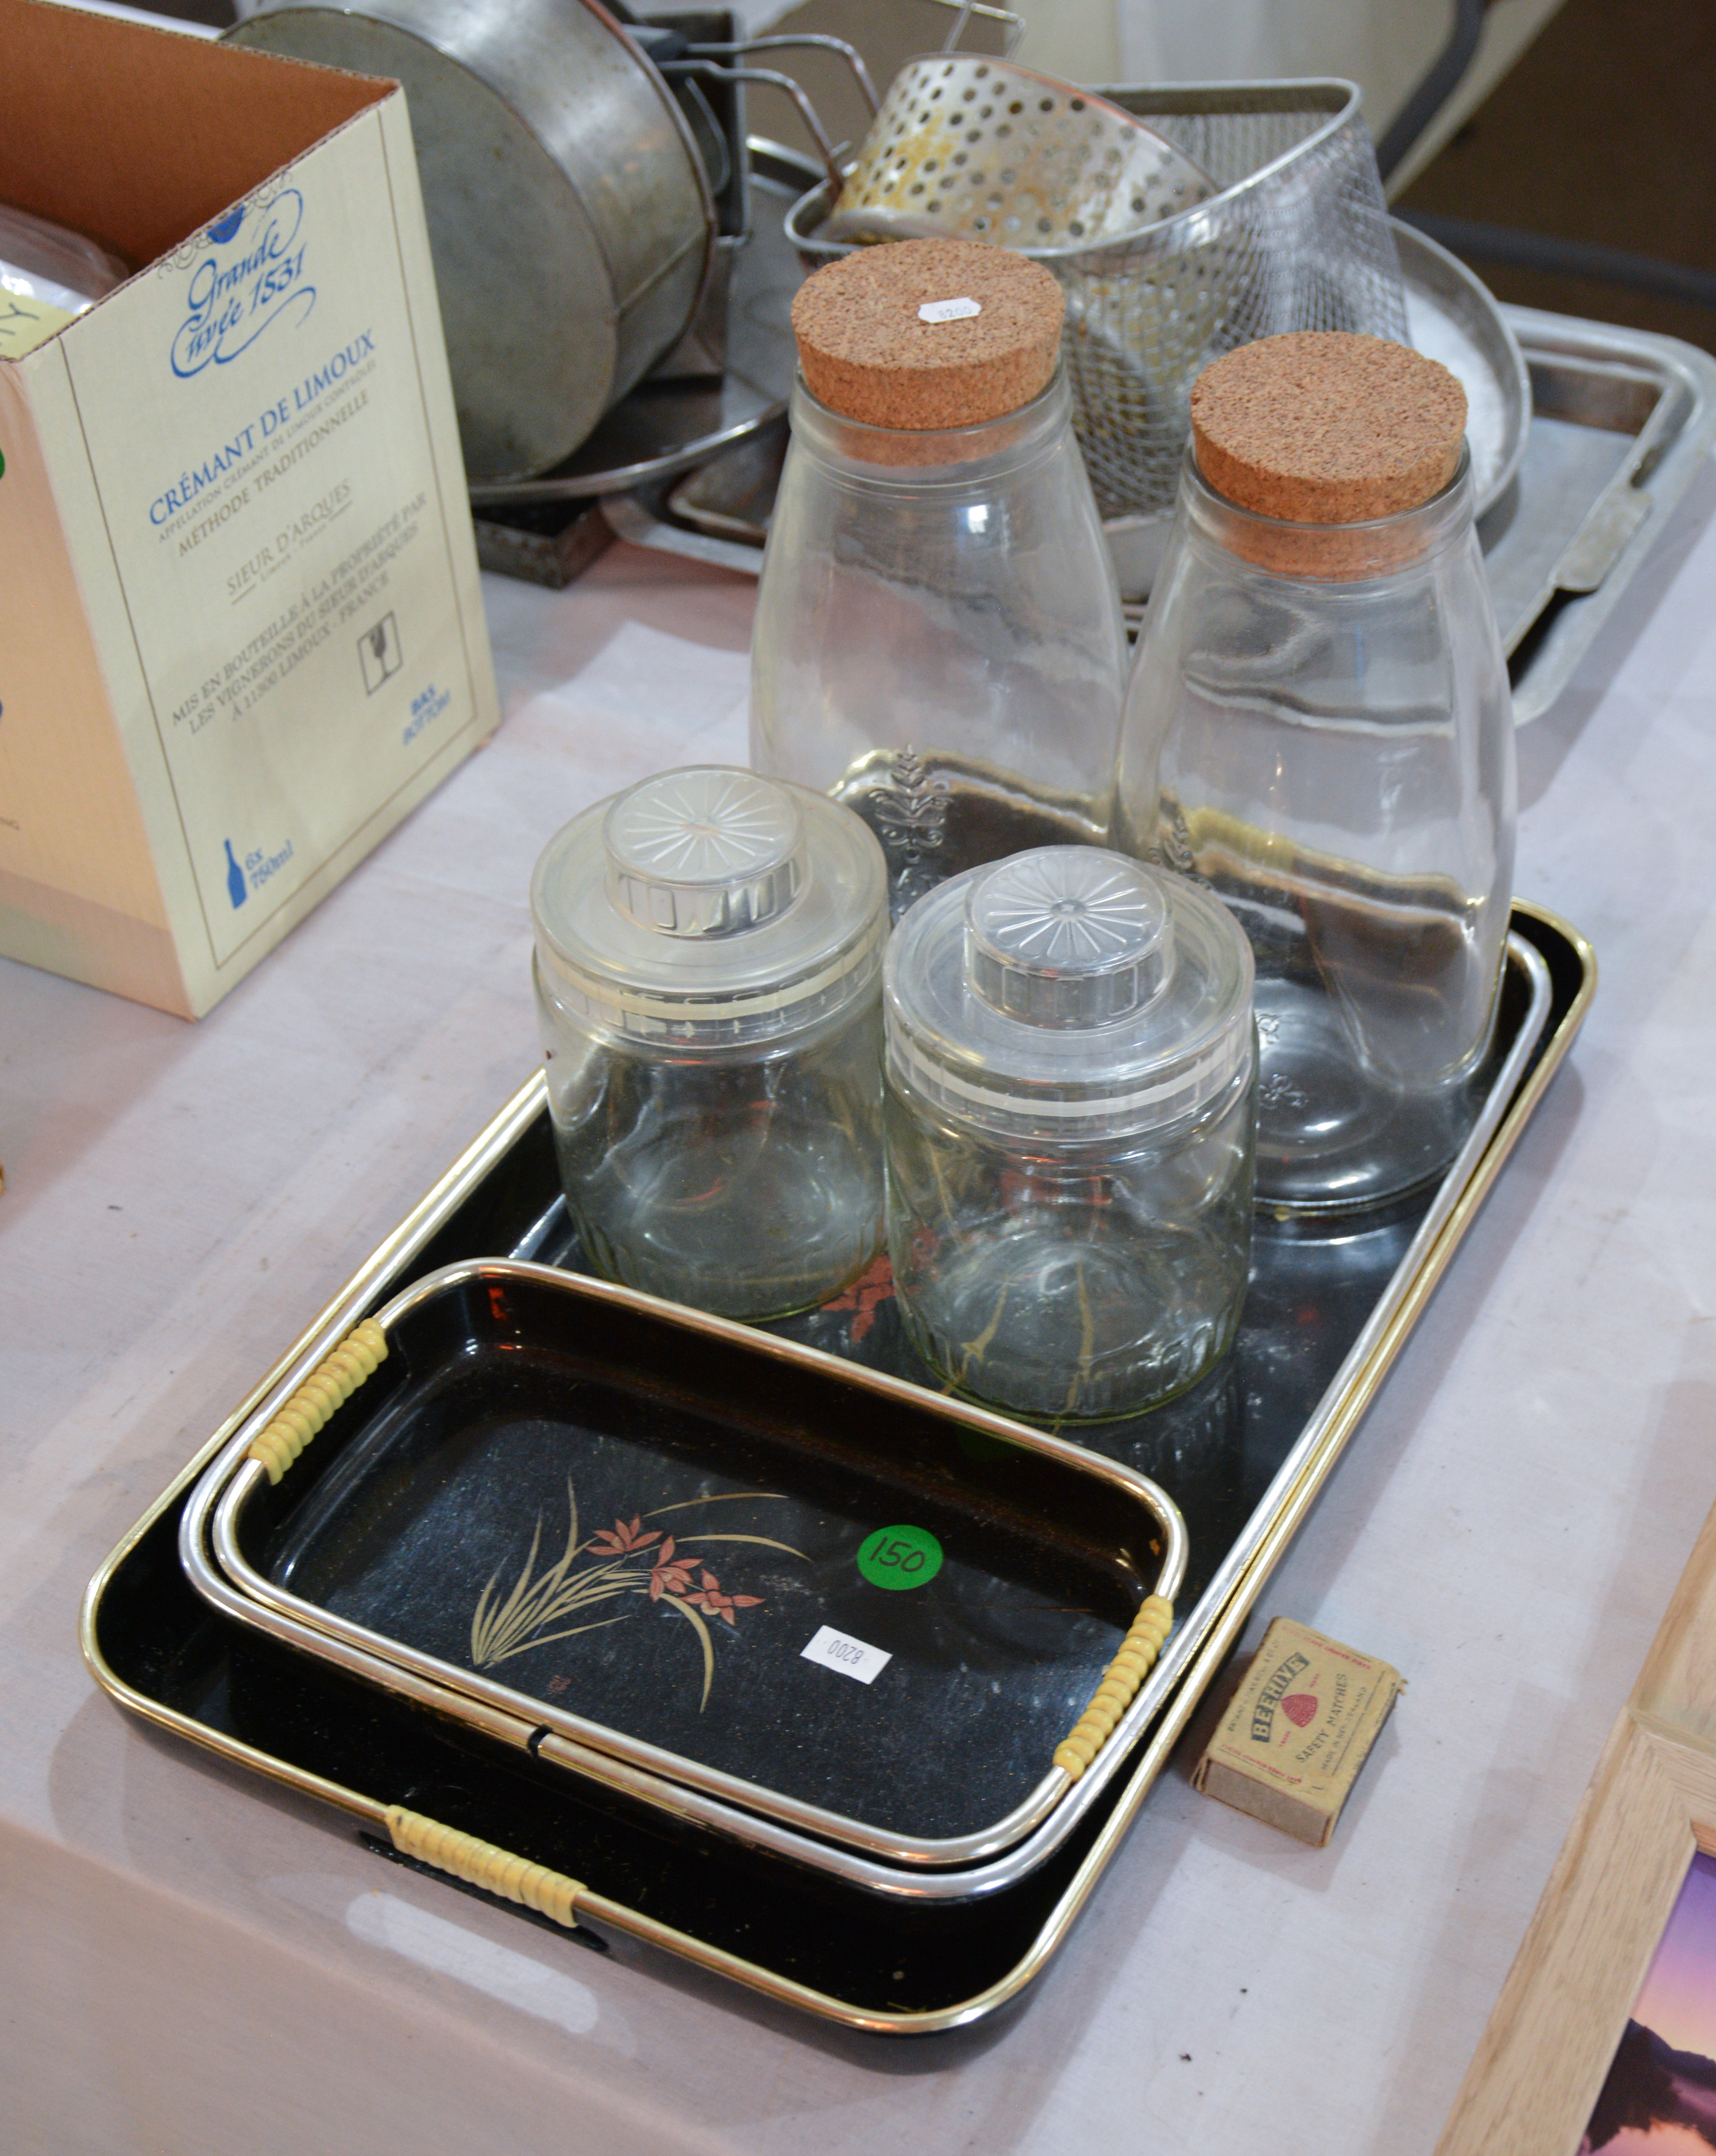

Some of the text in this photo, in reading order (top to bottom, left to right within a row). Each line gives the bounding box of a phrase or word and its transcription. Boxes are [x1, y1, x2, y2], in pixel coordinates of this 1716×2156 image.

[172, 242, 307, 378] Cuvée 1531
[188, 200, 300, 332] Grande
[938, 306, 972, 319] 8200
[149, 327, 375, 525] CRÉMANT DE LIMOUX
[159, 485, 222, 542] APPELLATION
[272, 434, 284, 450] DE
[287, 405, 322, 438] LIMOUX
[179, 388, 369, 557] MÉTHODE TRADITIONNELLE
[227, 479, 350, 595] SIEUR D'ARQUES
[172, 693, 199, 726] MIS
[201, 672, 221, 700] EN
[223, 604, 298, 680] BOUTEILLE
[311, 579, 330, 601] LA
[189, 702, 215, 734] LES
[216, 630, 295, 706] VIGNERONS
[296, 610, 316, 638] DU
[278, 621, 332, 677] LIMOUX
[339, 568, 389, 625] FRANCE
[245, 846, 263, 871] 6x
[250, 838, 294, 890] 750ml
[869, 1536, 925, 1573] 150
[827, 1640, 864, 1665] 8200
[1252, 1654, 1307, 1738] BEEHIVE
[1295, 1672, 1348, 1763] SAFETY MATCHES
[1321, 1749, 1335, 1770] MADE
[1332, 1738, 1340, 1749] IN
